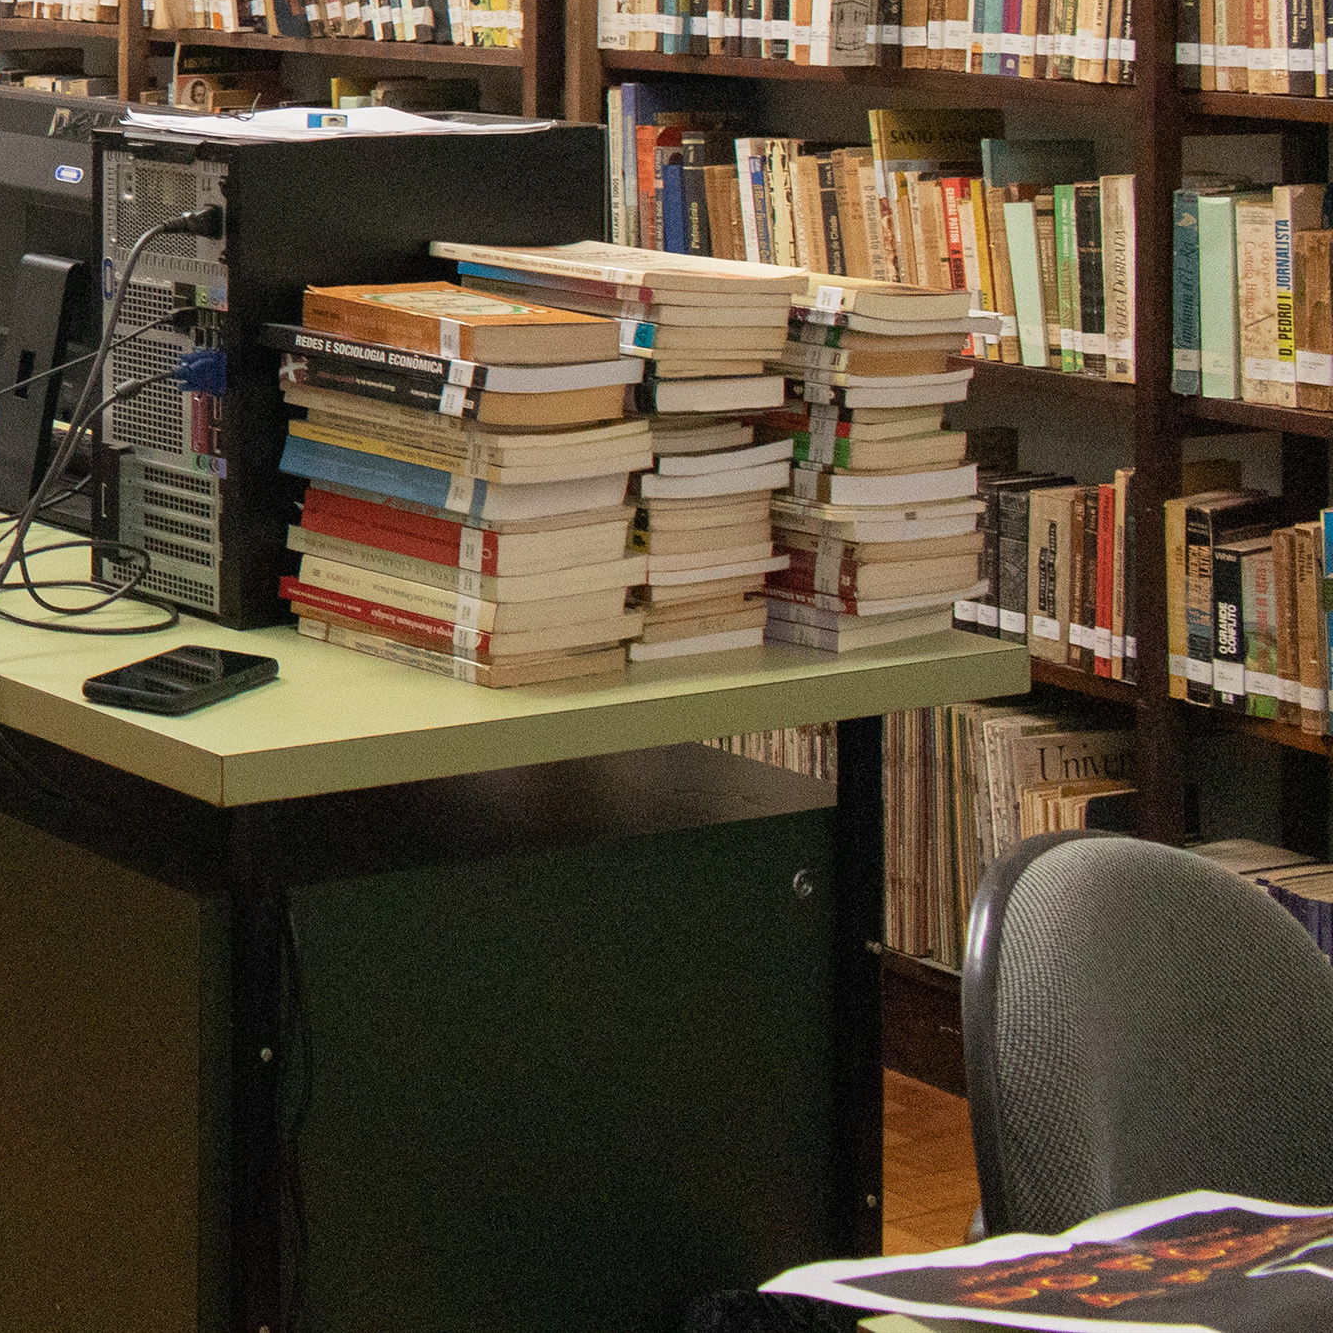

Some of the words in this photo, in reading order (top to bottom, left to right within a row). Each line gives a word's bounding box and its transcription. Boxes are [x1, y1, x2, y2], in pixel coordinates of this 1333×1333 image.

[865, 195, 880, 250] Pensamento
[873, 254, 883, 265] de
[949, 217, 960, 243] PATTON
[1274, 219, 1291, 290] JORNALISTA
[1278, 301, 1292, 341] PEDRO
[294, 334, 324, 354] REDES
[325, 339, 331, 354] E
[332, 340, 386, 363] SOCIOLOGIA
[387, 350, 444, 375] ECONÔMICA
[1278, 345, 1293, 356] D.
[1218, 602, 1229, 645] GRANDE
[1227, 604, 1238, 654] CONFLITO
[1219, 645, 1228, 654] O
